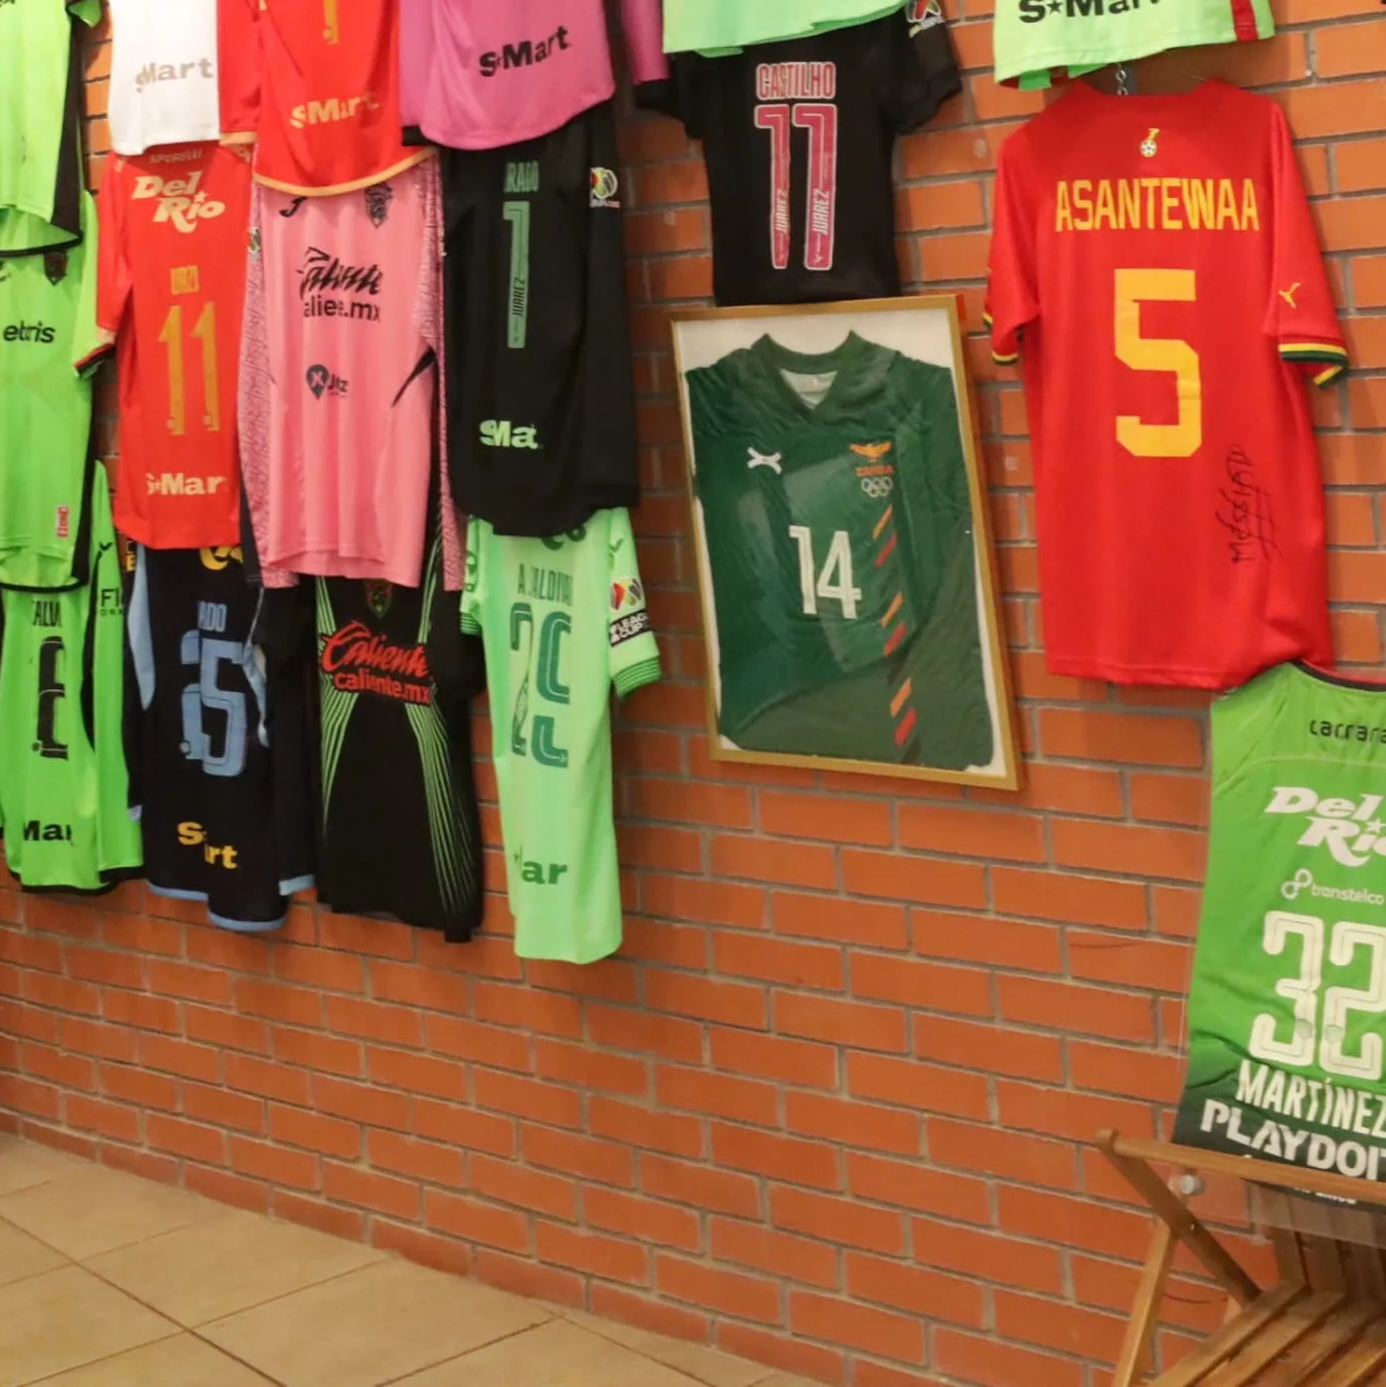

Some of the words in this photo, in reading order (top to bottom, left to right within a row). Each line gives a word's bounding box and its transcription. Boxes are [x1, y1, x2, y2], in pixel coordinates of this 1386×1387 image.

[130, 170, 205, 200] Del
[152, 190, 227, 235] Rio
[1054, 178, 1260, 233] ASANTEWAA
[503, 199, 531, 350] 1
[157, 300, 222, 437] 11
[1114, 268, 1203, 458] 5
[788, 525, 862, 620] 14
[1264, 785, 1386, 820] Del
[1311, 881, 1386, 908] transtelco
